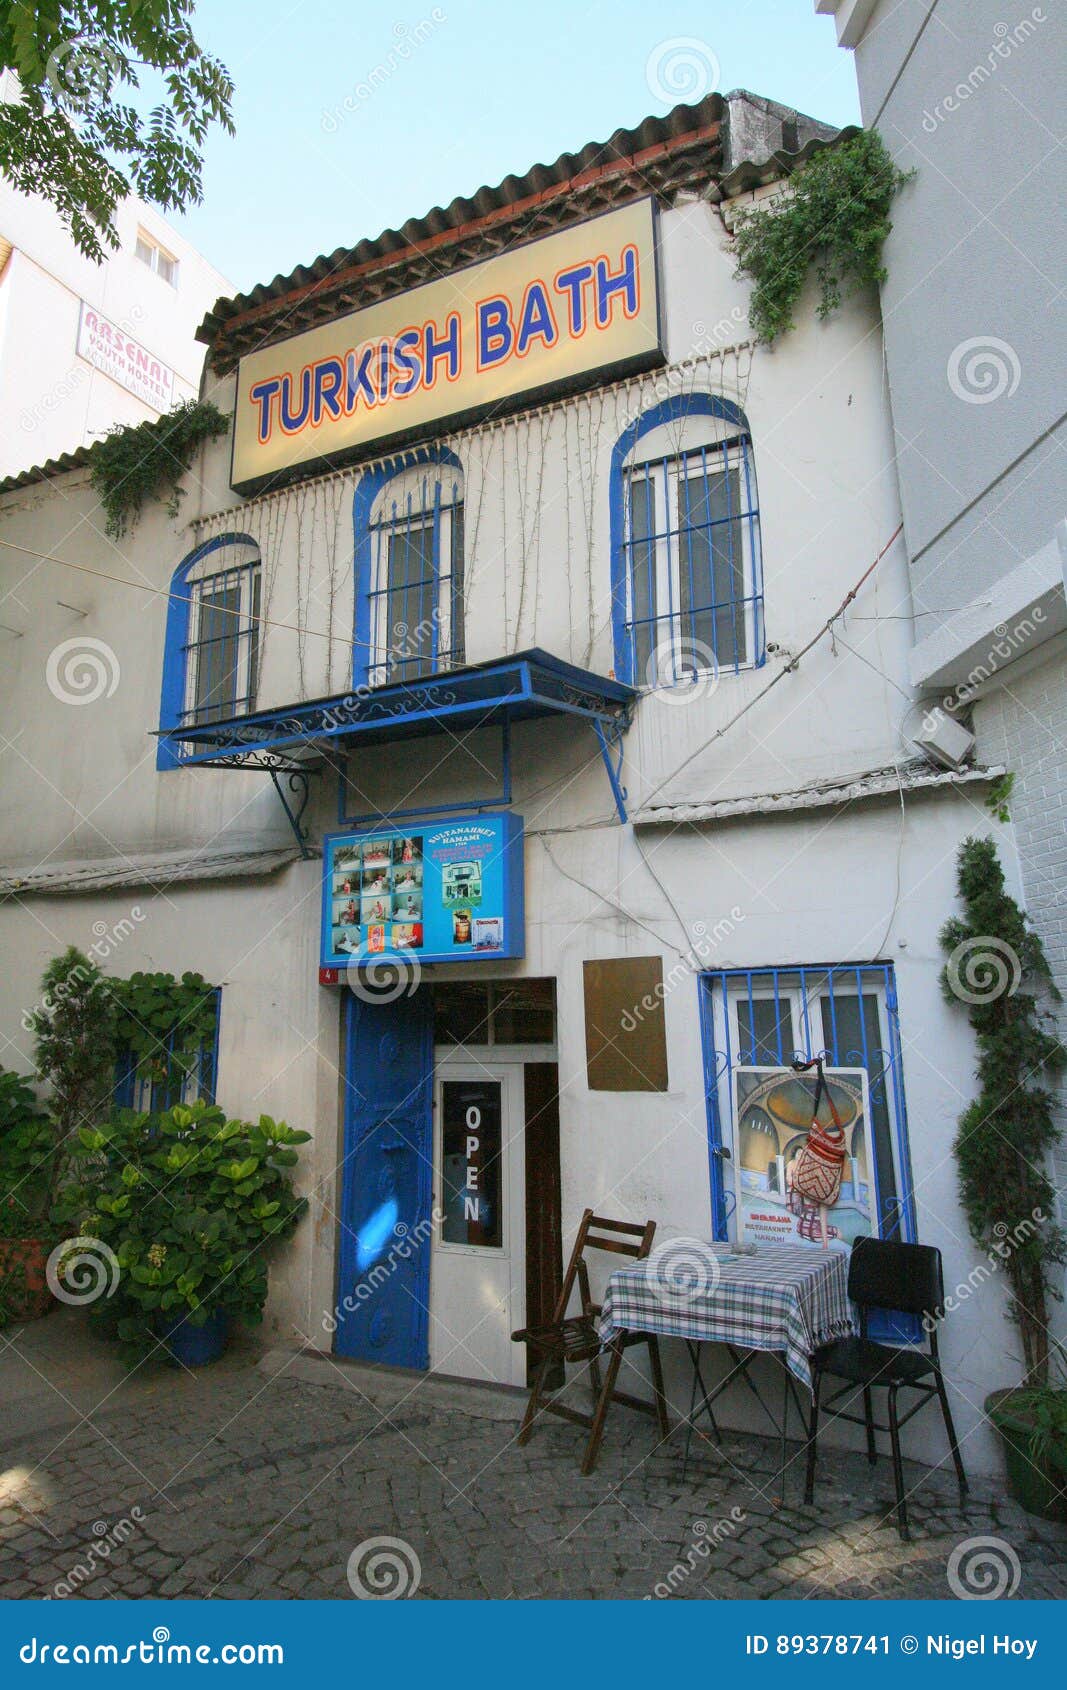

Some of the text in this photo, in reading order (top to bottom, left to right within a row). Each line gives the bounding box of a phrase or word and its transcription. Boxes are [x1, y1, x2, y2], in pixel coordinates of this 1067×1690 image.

[85, 312, 170, 388] ARSENAL
[90, 333, 166, 399] YOUTH HOSTEL
[250, 243, 640, 445] TURKISH BATH
[464, 1106, 481, 1221] OPEN
